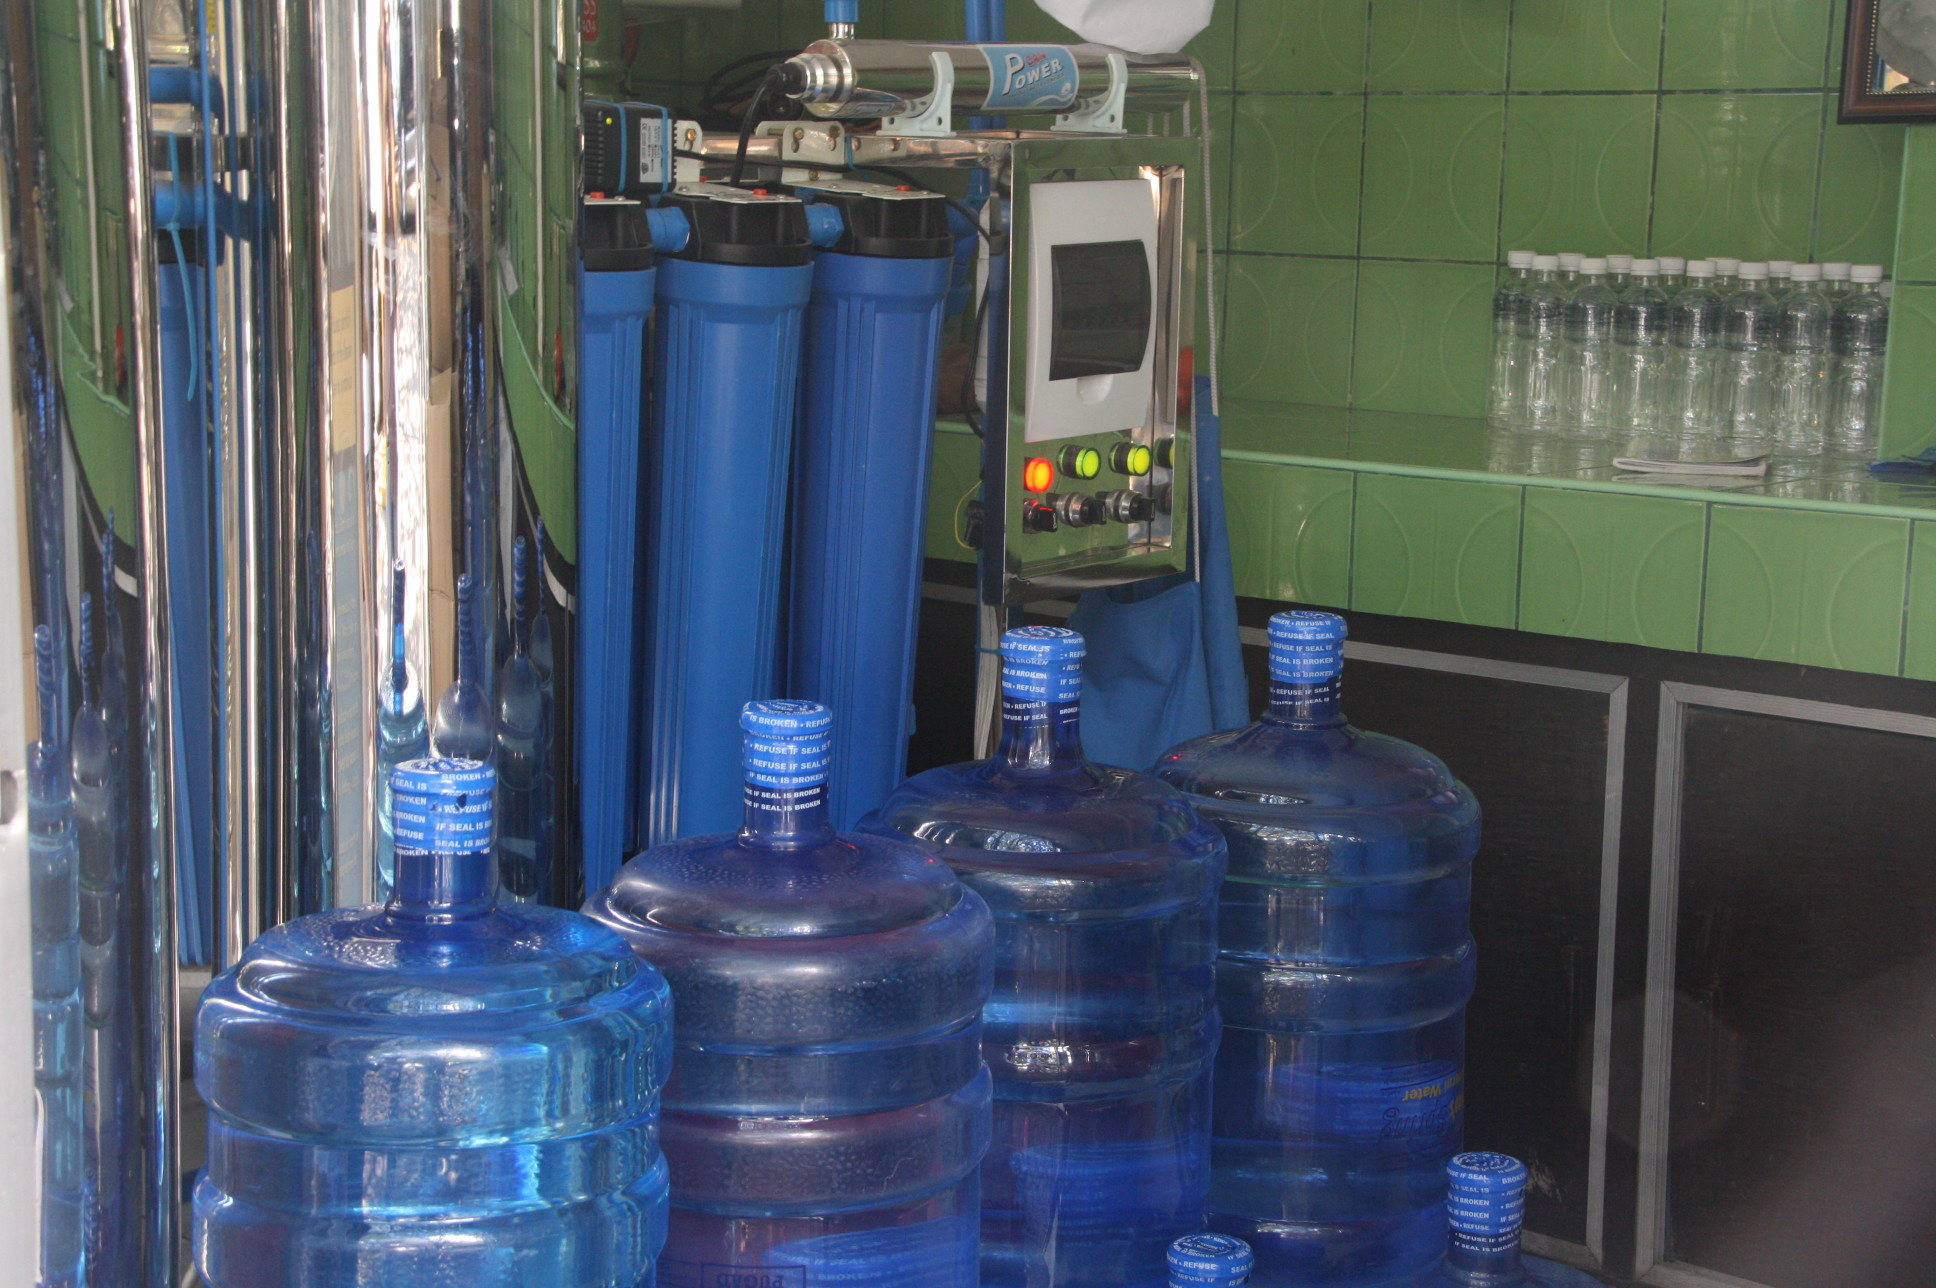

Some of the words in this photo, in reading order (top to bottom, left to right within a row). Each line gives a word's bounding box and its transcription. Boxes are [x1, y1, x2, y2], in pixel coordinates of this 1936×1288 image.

[1002, 53, 1063, 96] POWER
[1018, 643, 1041, 652] SEAL
[1273, 640, 1295, 651] REFUSE
[1296, 644, 1304, 652] IF
[1305, 644, 1325, 652] SEAL
[1276, 655, 1291, 665] SEAL
[1303, 656, 1334, 665] BROKEN
[1015, 669, 1048, 679] BROKEN
[1275, 667, 1292, 677] SEAL
[1303, 670, 1334, 678] BROKEN
[1016, 683, 1046, 693] REFUSE
[1276, 687, 1304, 696] REFUSE
[1314, 686, 1330, 694] SEAL
[1014, 701, 1040, 710] REFUSE
[1040, 700, 1048, 708] IF
[749, 714, 757, 722] IS
[758, 716, 798, 729] BROKEN
[753, 743, 788, 755] REFUSE
[789, 745, 799, 755] IF
[801, 746, 821, 755] SEAL
[821, 743, 828, 751] IS
[753, 758, 787, 770] REFUSE
[789, 763, 798, 771] IF
[800, 760, 821, 770] SEAL
[821, 758, 828, 766] IS
[441, 772, 481, 781] BROKEN
[756, 773, 778, 784] SEAL
[780, 776, 790, 784] IS
[792, 772, 823, 784] BROKEN
[395, 778, 415, 790] SEAL
[417, 781, 427, 790] IS
[761, 791, 781, 799] SEAL
[783, 791, 792, 799] IS
[793, 787, 821, 798] BROKEN
[753, 800, 760, 808] IF
[761, 802, 782, 812] SEAL
[784, 802, 792, 811] IS
[794, 799, 821, 810] BROKEN
[436, 822, 445, 831] IF
[448, 822, 475, 832] SEAL
[475, 821, 484, 830] IS
[434, 840, 462, 848] SEAL
[463, 839, 474, 847] IS
[1459, 1197, 1490, 1206] BROKEN
[1459, 1210, 1490, 1219] BROKEN
[1462, 1222, 1490, 1231] REFUSE
[1458, 1232, 1488, 1243] REFUSE
[1498, 1233, 1514, 1243] SEAL
[1461, 1243, 1480, 1251] SEAL
[1183, 1260, 1219, 1271] REFUSE
[1231, 1263, 1248, 1274] SEAL
